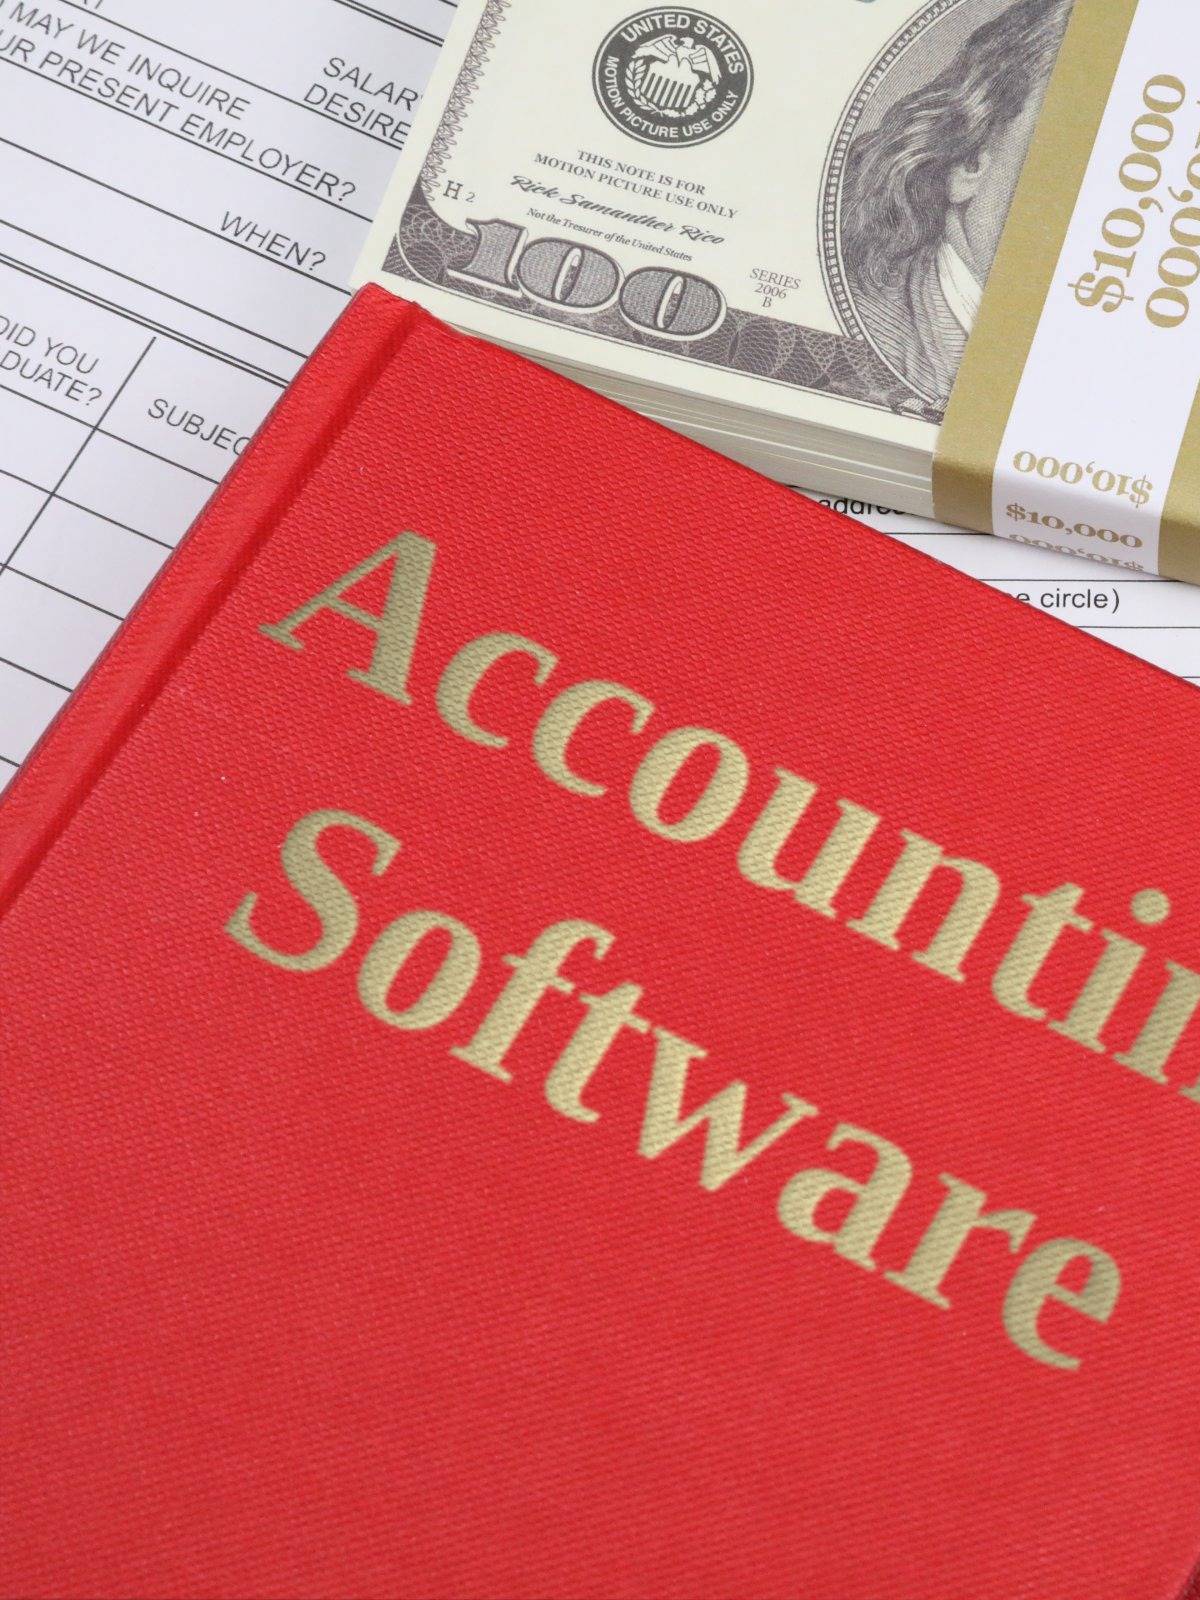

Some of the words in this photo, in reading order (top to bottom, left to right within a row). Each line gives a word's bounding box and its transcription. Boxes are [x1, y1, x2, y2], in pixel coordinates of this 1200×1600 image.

[9, 2, 74, 39] MAY
[77, 29, 126, 65] WE
[127, 54, 251, 120] INQUIRE
[620, 14, 690, 43] UNITED
[693, 20, 744, 74] STATES
[323, 57, 423, 111] SALAR
[604, 56, 625, 109] MOTION
[619, 108, 679, 138] PICTURE
[682, 119, 712, 137] USE
[711, 90, 739, 122] ONLY
[38, 51, 179, 122] PRESENT
[181, 113, 356, 201] EMPLOYER?
[533, 153, 596, 180] MOTION
[597, 172, 663, 200] PICTURE
[665, 192, 694, 208] USE
[696, 200, 738, 219] ONLY
[577, 150, 613, 169] THIS
[616, 161, 655, 182] NOTE
[658, 174, 673, 187] IS
[675, 178, 706, 195] FOR
[1068, 74, 1186, 313] $10,000
[221, 211, 327, 271] WHEN?
[526, 207, 546, 220] Not
[546, 213, 561, 225] the
[562, 218, 605, 237] Tresurer
[604, 232, 615, 242] of
[614, 234, 630, 246] the
[632, 239, 664, 256] United
[663, 247, 693, 261] States
[447, 217, 729, 341] 100
[750, 268, 801, 290] SERIES
[754, 282, 788, 299] 2006
[762, 296, 772, 307] B
[44, 337, 99, 374] YOU
[1013, 451, 1153, 508] $10,000
[1006, 503, 1143, 547] $10,000
[1040, 588, 1120, 613] circle)
[221, 808, 1123, 1372] Software
